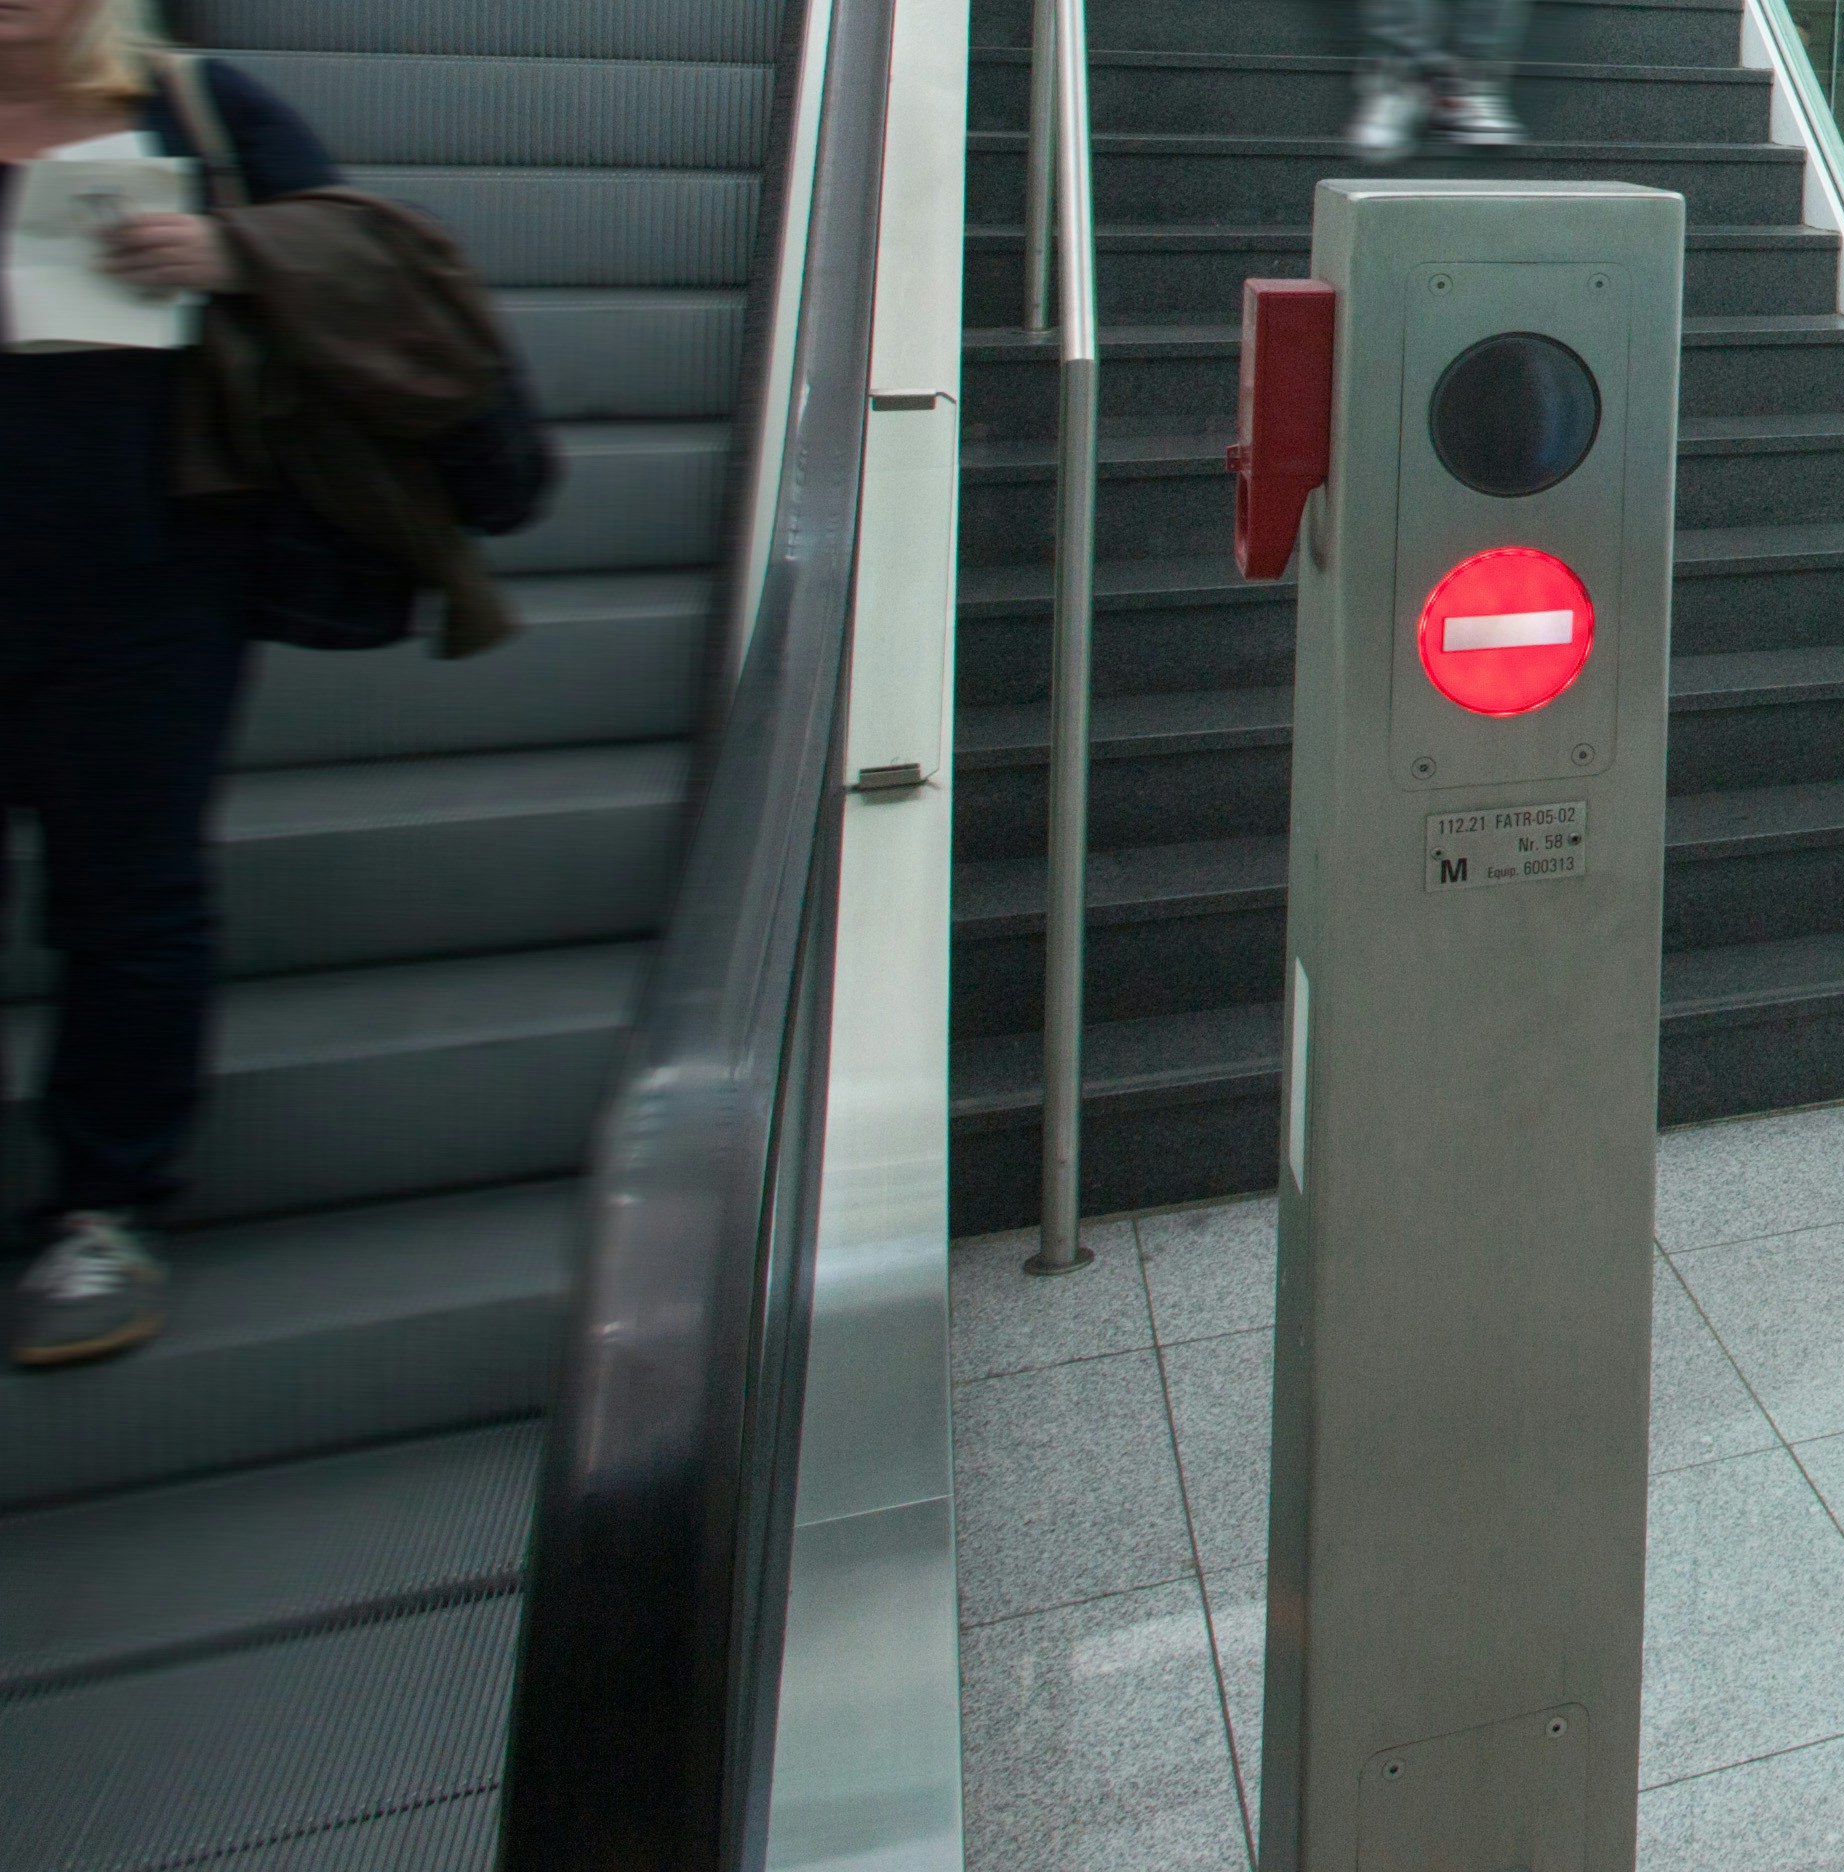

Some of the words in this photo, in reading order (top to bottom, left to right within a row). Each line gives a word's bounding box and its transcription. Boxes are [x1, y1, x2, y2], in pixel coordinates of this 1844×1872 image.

[1438, 816, 1486, 835] 112.21
[1495, 807, 1576, 829] FATR-05-02
[1518, 837, 1539, 853] Nr.
[1544, 834, 1564, 850] 58
[1440, 857, 1468, 884] M
[1487, 866, 1519, 880] Equip.
[1523, 857, 1575, 876] 600313
